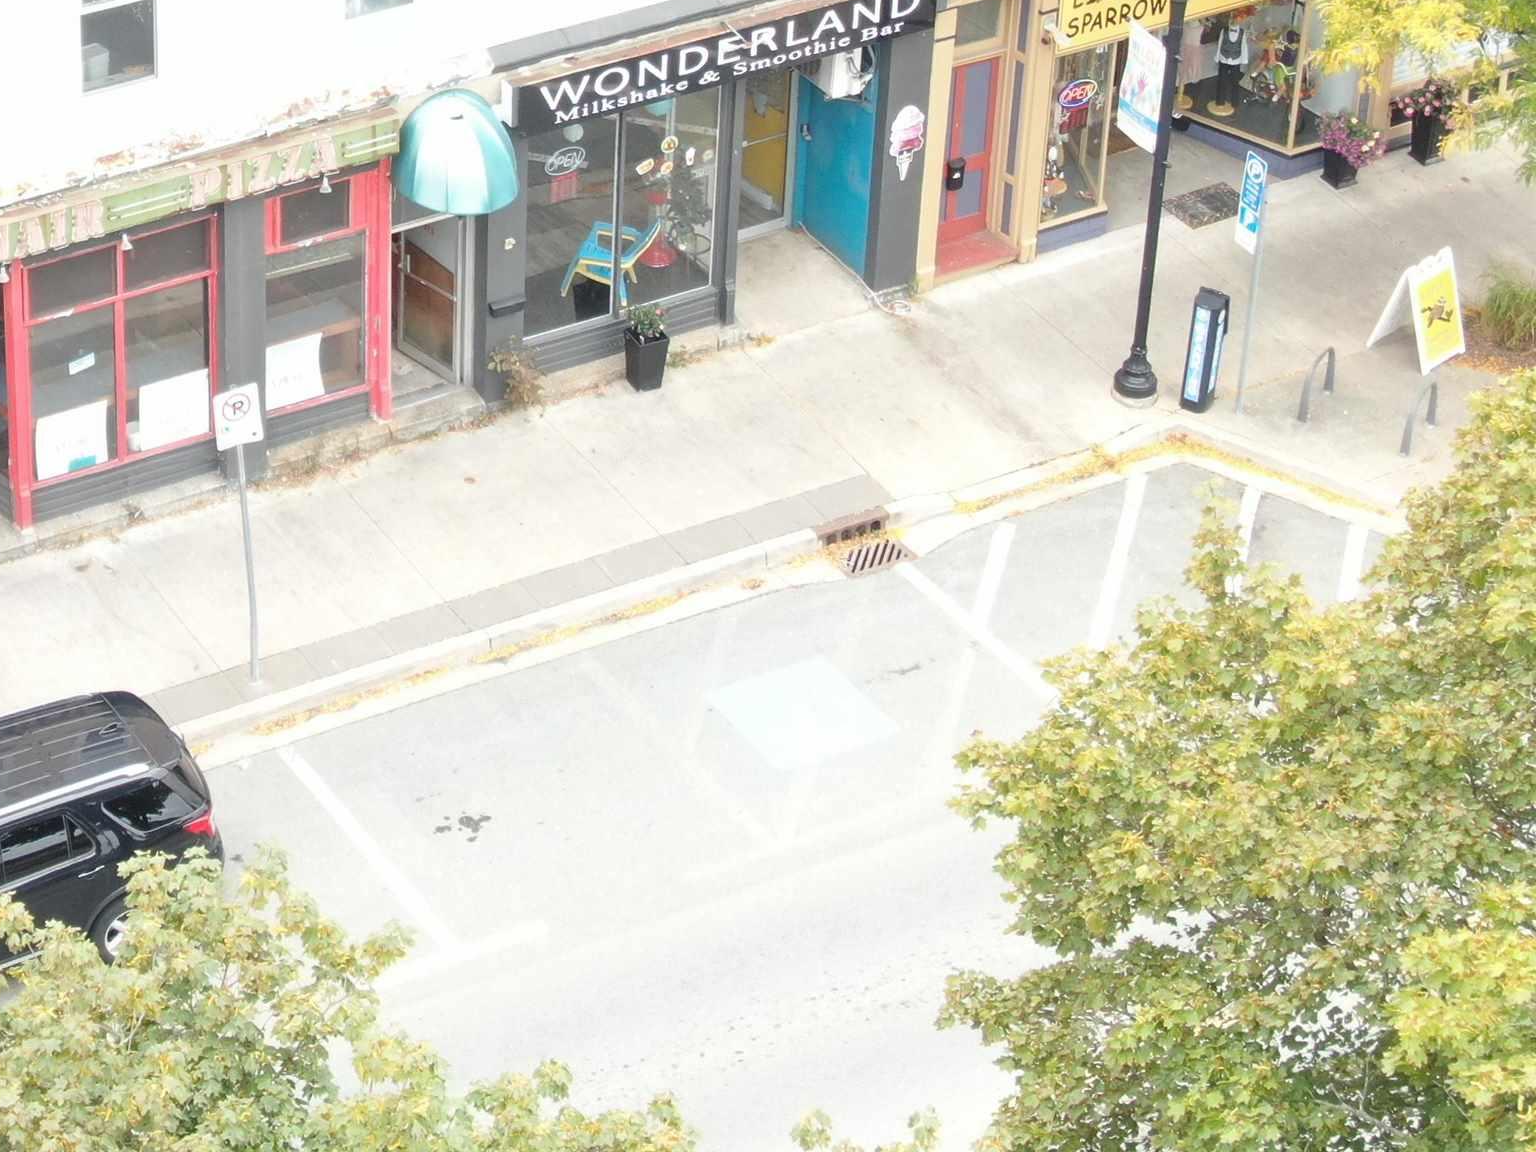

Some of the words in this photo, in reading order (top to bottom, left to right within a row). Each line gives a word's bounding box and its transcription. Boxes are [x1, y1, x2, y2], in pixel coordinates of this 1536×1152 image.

[553, 78, 689, 125] Milkshake
[698, 69, 721, 85] &
[732, 34, 851, 78] Smoothie
[859, 21, 905, 43] Bar
[1062, 83, 1095, 104] OPEN
[190, 136, 340, 211] PIZZA
[547, 150, 583, 172] OPEN
